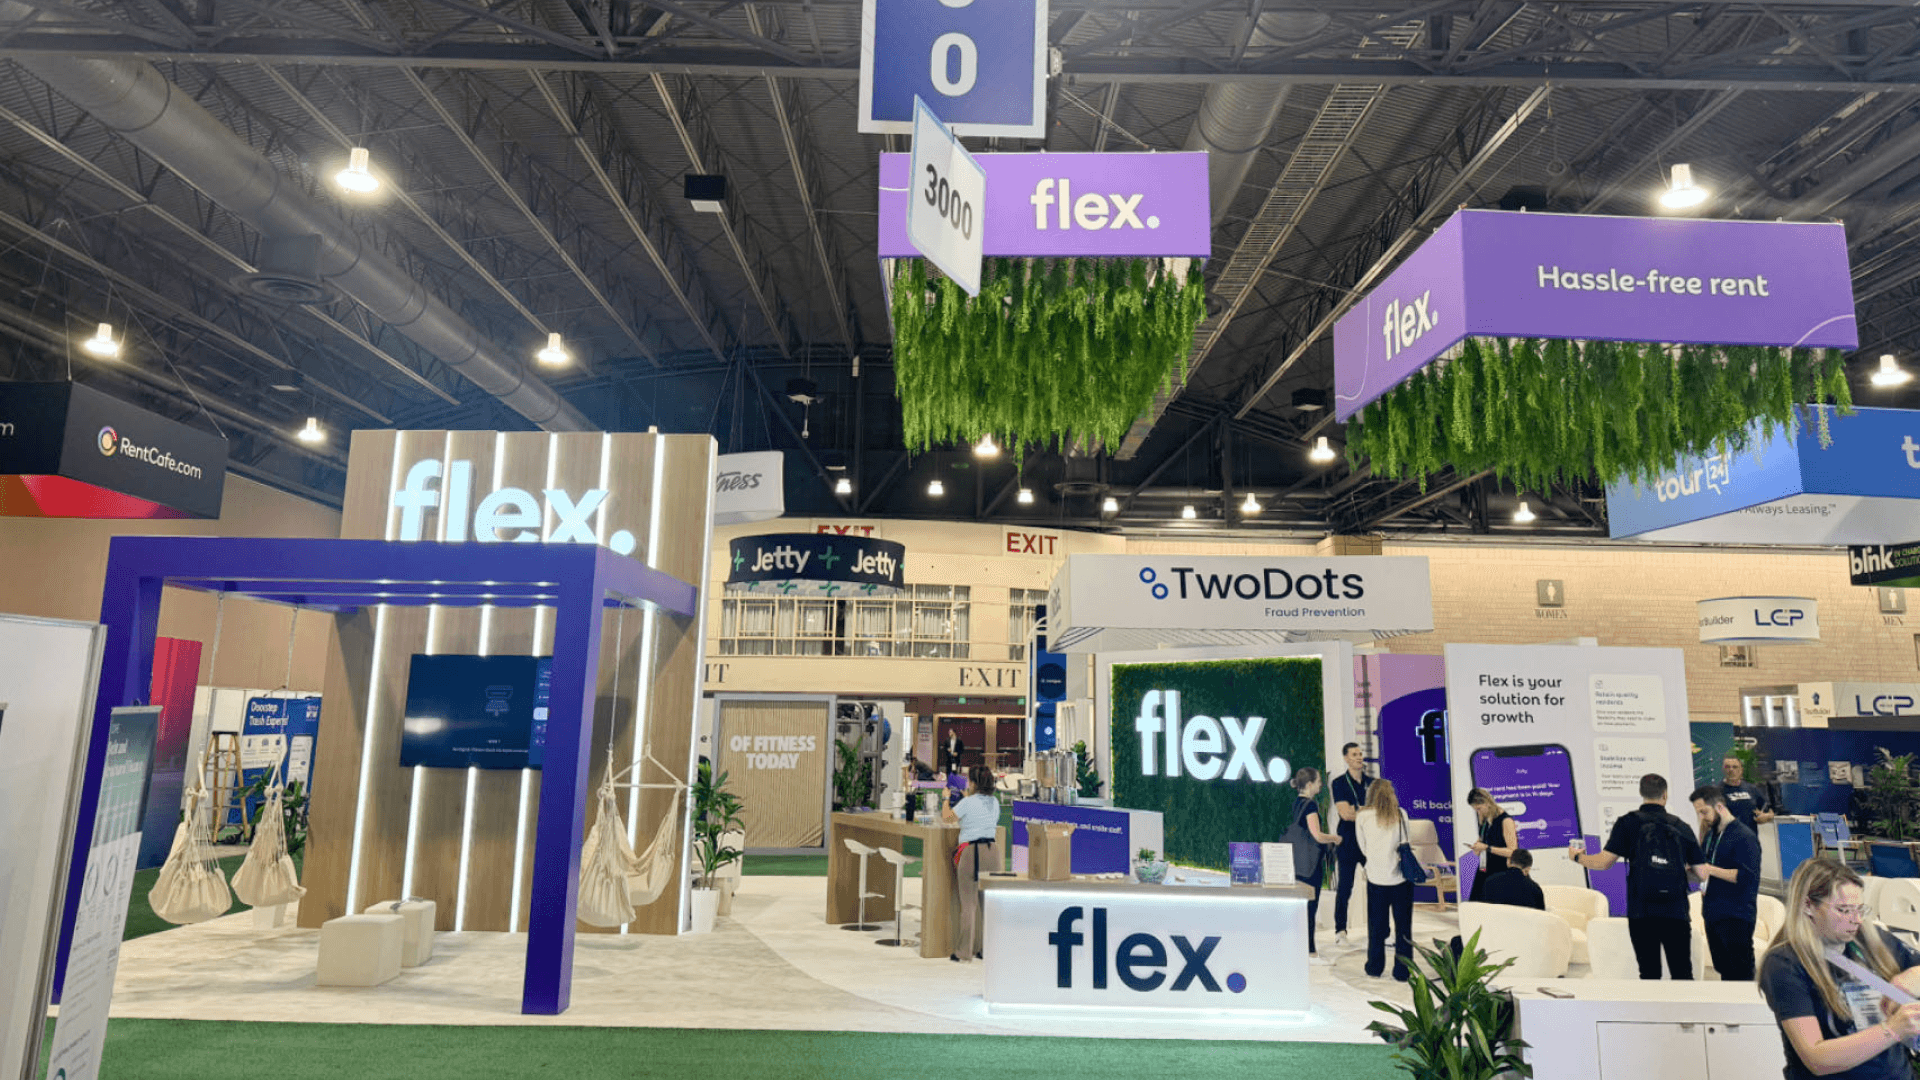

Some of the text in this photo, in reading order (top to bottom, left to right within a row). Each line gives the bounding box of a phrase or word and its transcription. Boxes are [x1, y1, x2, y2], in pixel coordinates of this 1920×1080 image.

[924, 163, 973, 241] 3000
[1030, 177, 1160, 231] flex.
[1537, 265, 1770, 298] Hassle-free rent
[1382, 289, 1439, 362] flex.
[119, 437, 202, 480] RentCafe.com
[394, 458, 637, 556] flex.
[1006, 532, 1059, 555] EXIT
[751, 546, 897, 580] Jetty Jetty
[1850, 544, 1895, 576] blink
[1171, 568, 1365, 600] TwoDots
[1264, 606, 1366, 618] Fraud Prevention
[1755, 608, 1804, 627] LCP
[704, 663, 730, 684] IT
[958, 666, 1022, 688] EXIT
[1478, 675, 1563, 693] Flex is your
[1479, 692, 1566, 707] solution for
[1855, 694, 1915, 717] LCP
[1480, 710, 1535, 726] growth
[730, 734, 816, 752] OF FITNESS
[1134, 689, 1292, 783] flex.
[746, 752, 800, 770] TODAY
[1413, 799, 1452, 810] Sit bac
[1048, 905, 1247, 994] flex.
